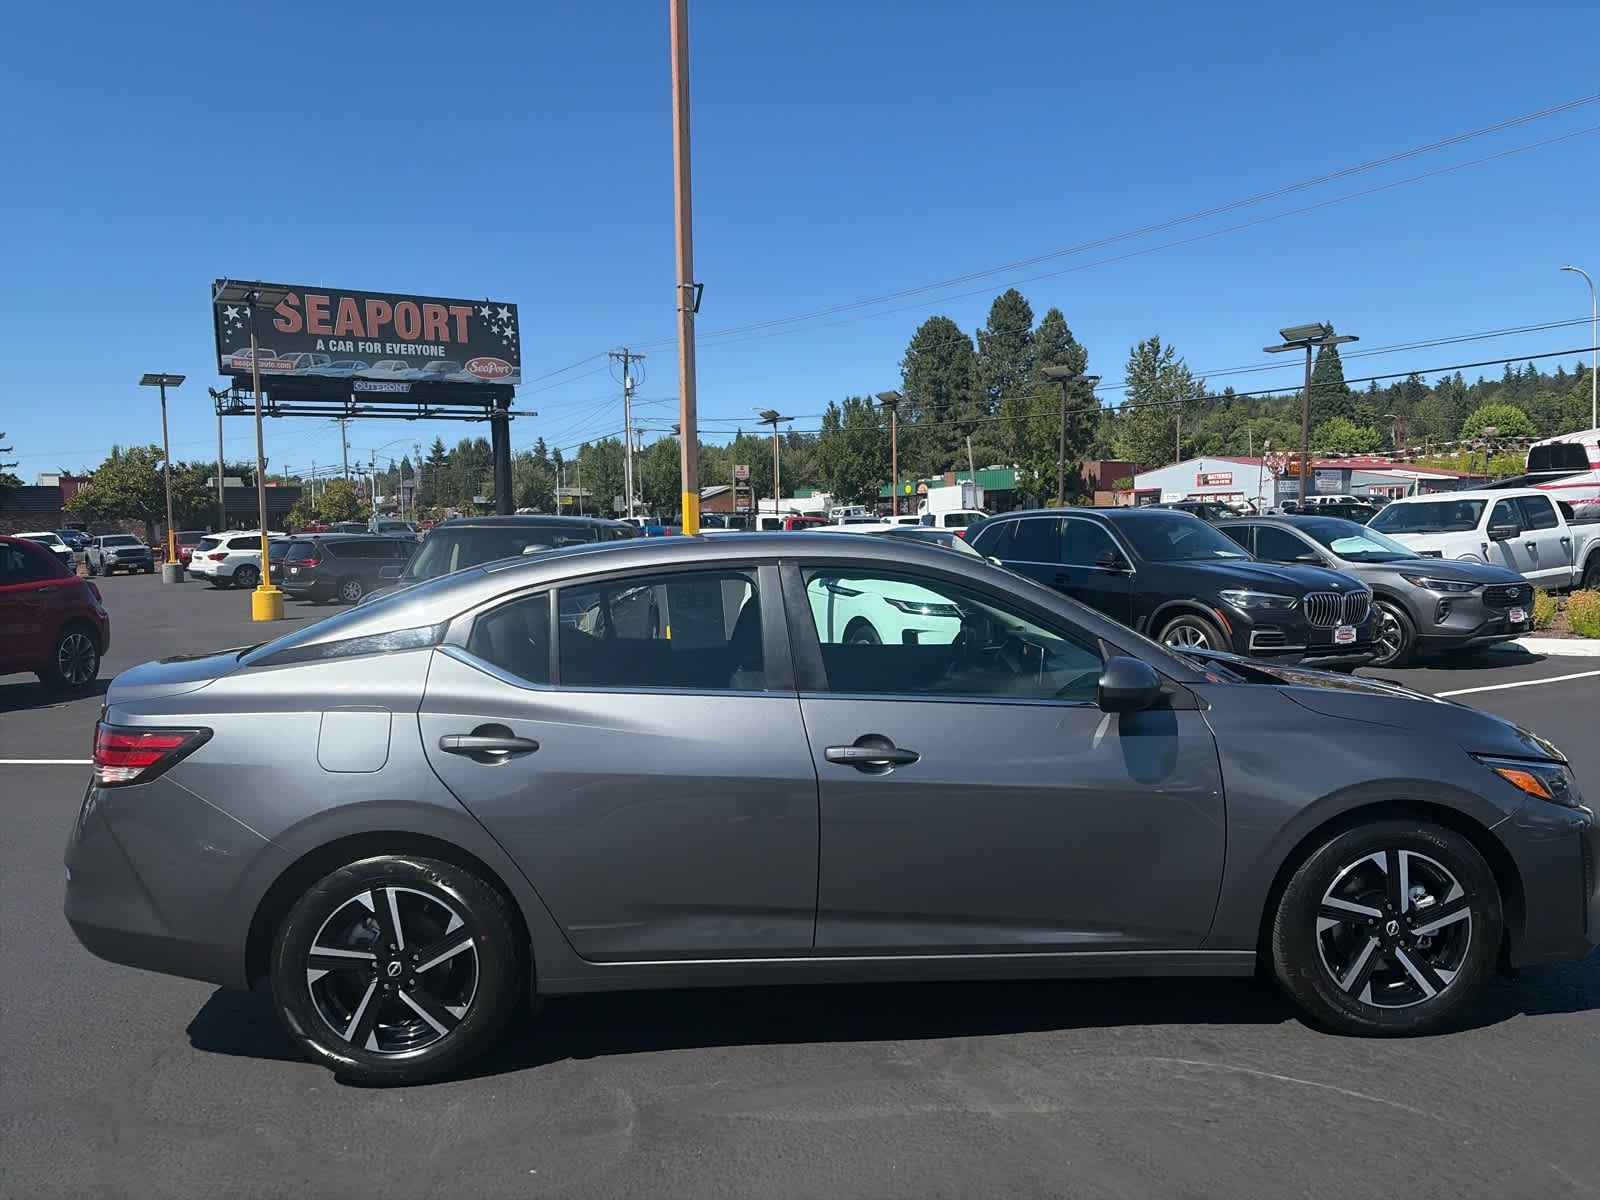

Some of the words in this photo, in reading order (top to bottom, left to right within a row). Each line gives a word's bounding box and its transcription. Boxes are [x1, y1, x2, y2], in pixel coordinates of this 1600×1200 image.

[272, 292, 473, 343] SEAPORT
[316, 339, 325, 351] A
[329, 340, 354, 353] CAR
[358, 341, 381, 353] FOR
[386, 343, 446, 357] EVERYONE
